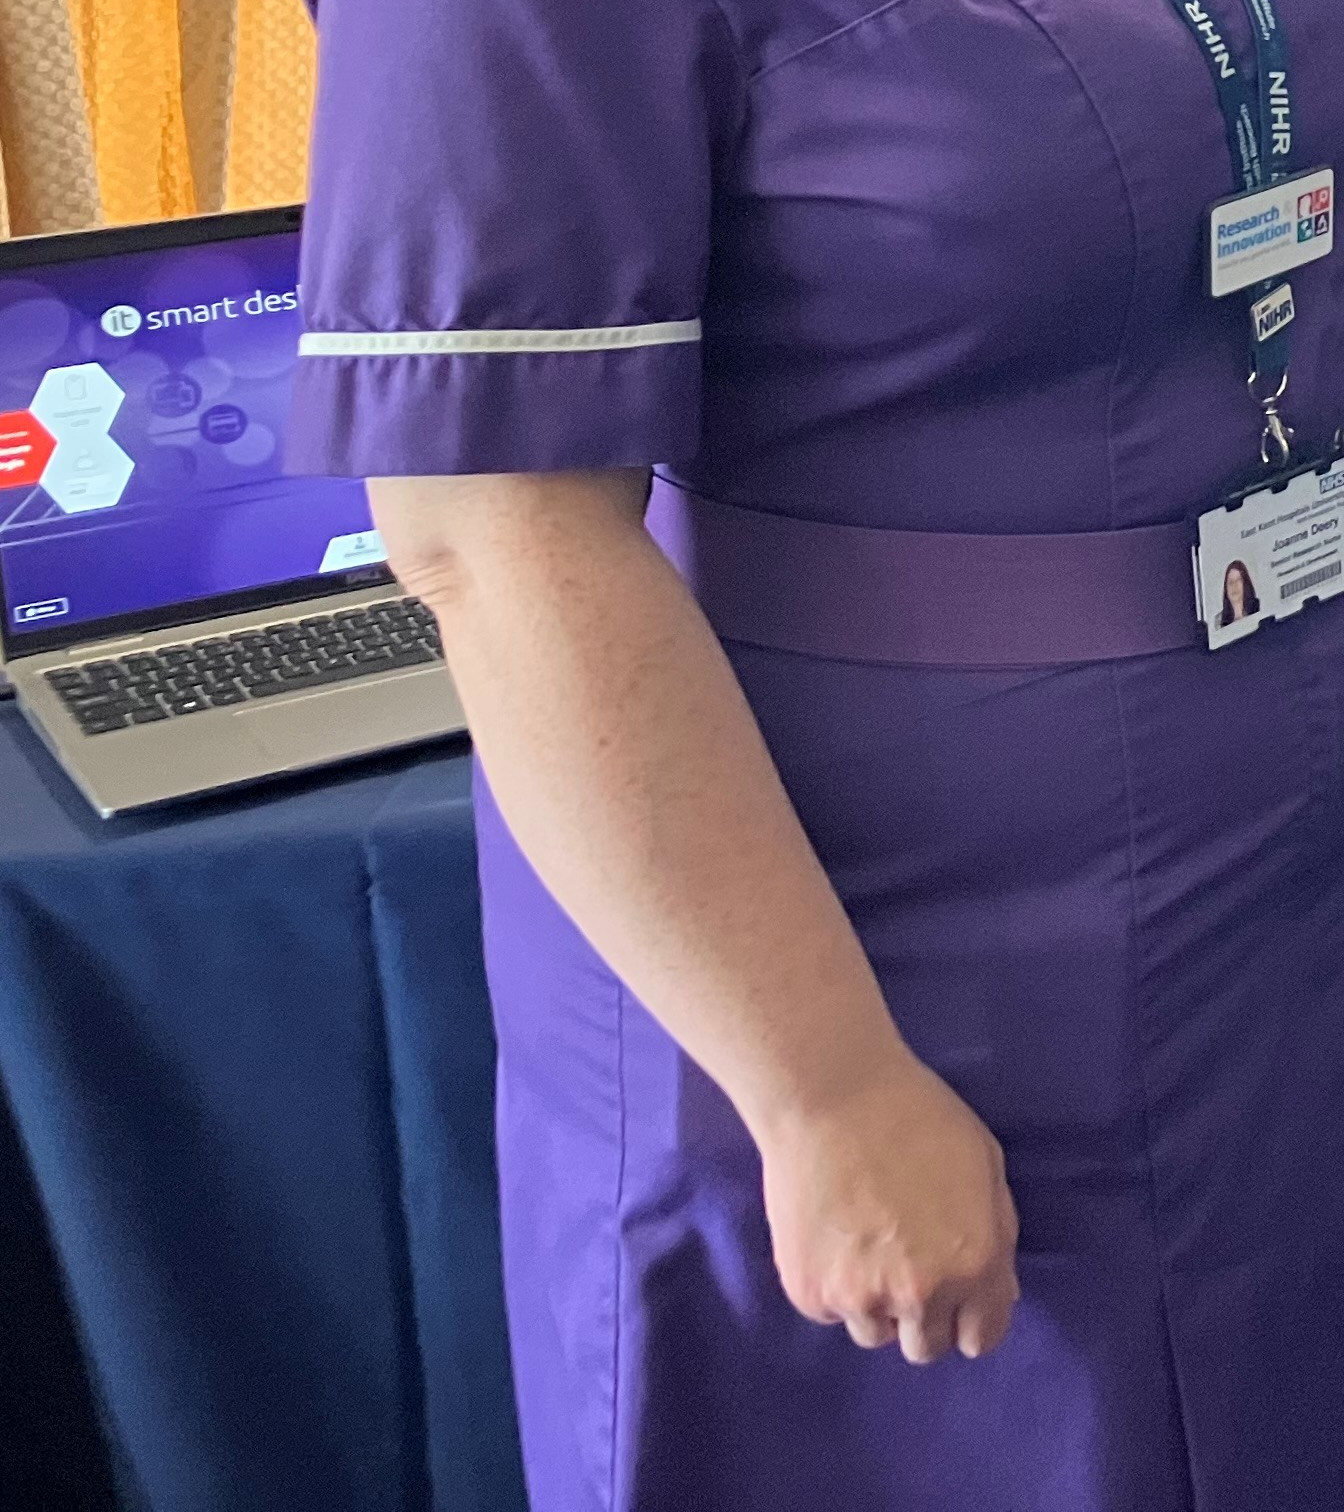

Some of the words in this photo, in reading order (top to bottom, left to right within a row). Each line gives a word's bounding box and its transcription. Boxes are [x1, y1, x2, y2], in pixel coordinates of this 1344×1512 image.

[1185, 0, 1235, 78] NIHR
[1269, 71, 1291, 154] NIHR
[1217, 221, 1292, 259] Innovation
[1218, 205, 1280, 239] Research
[110, 309, 135, 333] it
[146, 297, 239, 330] smart
[244, 284, 301, 315] des
[1259, 299, 1293, 337] NIHR
[1272, 529, 1308, 552] Joanne
[1310, 516, 1339, 536] Deery
